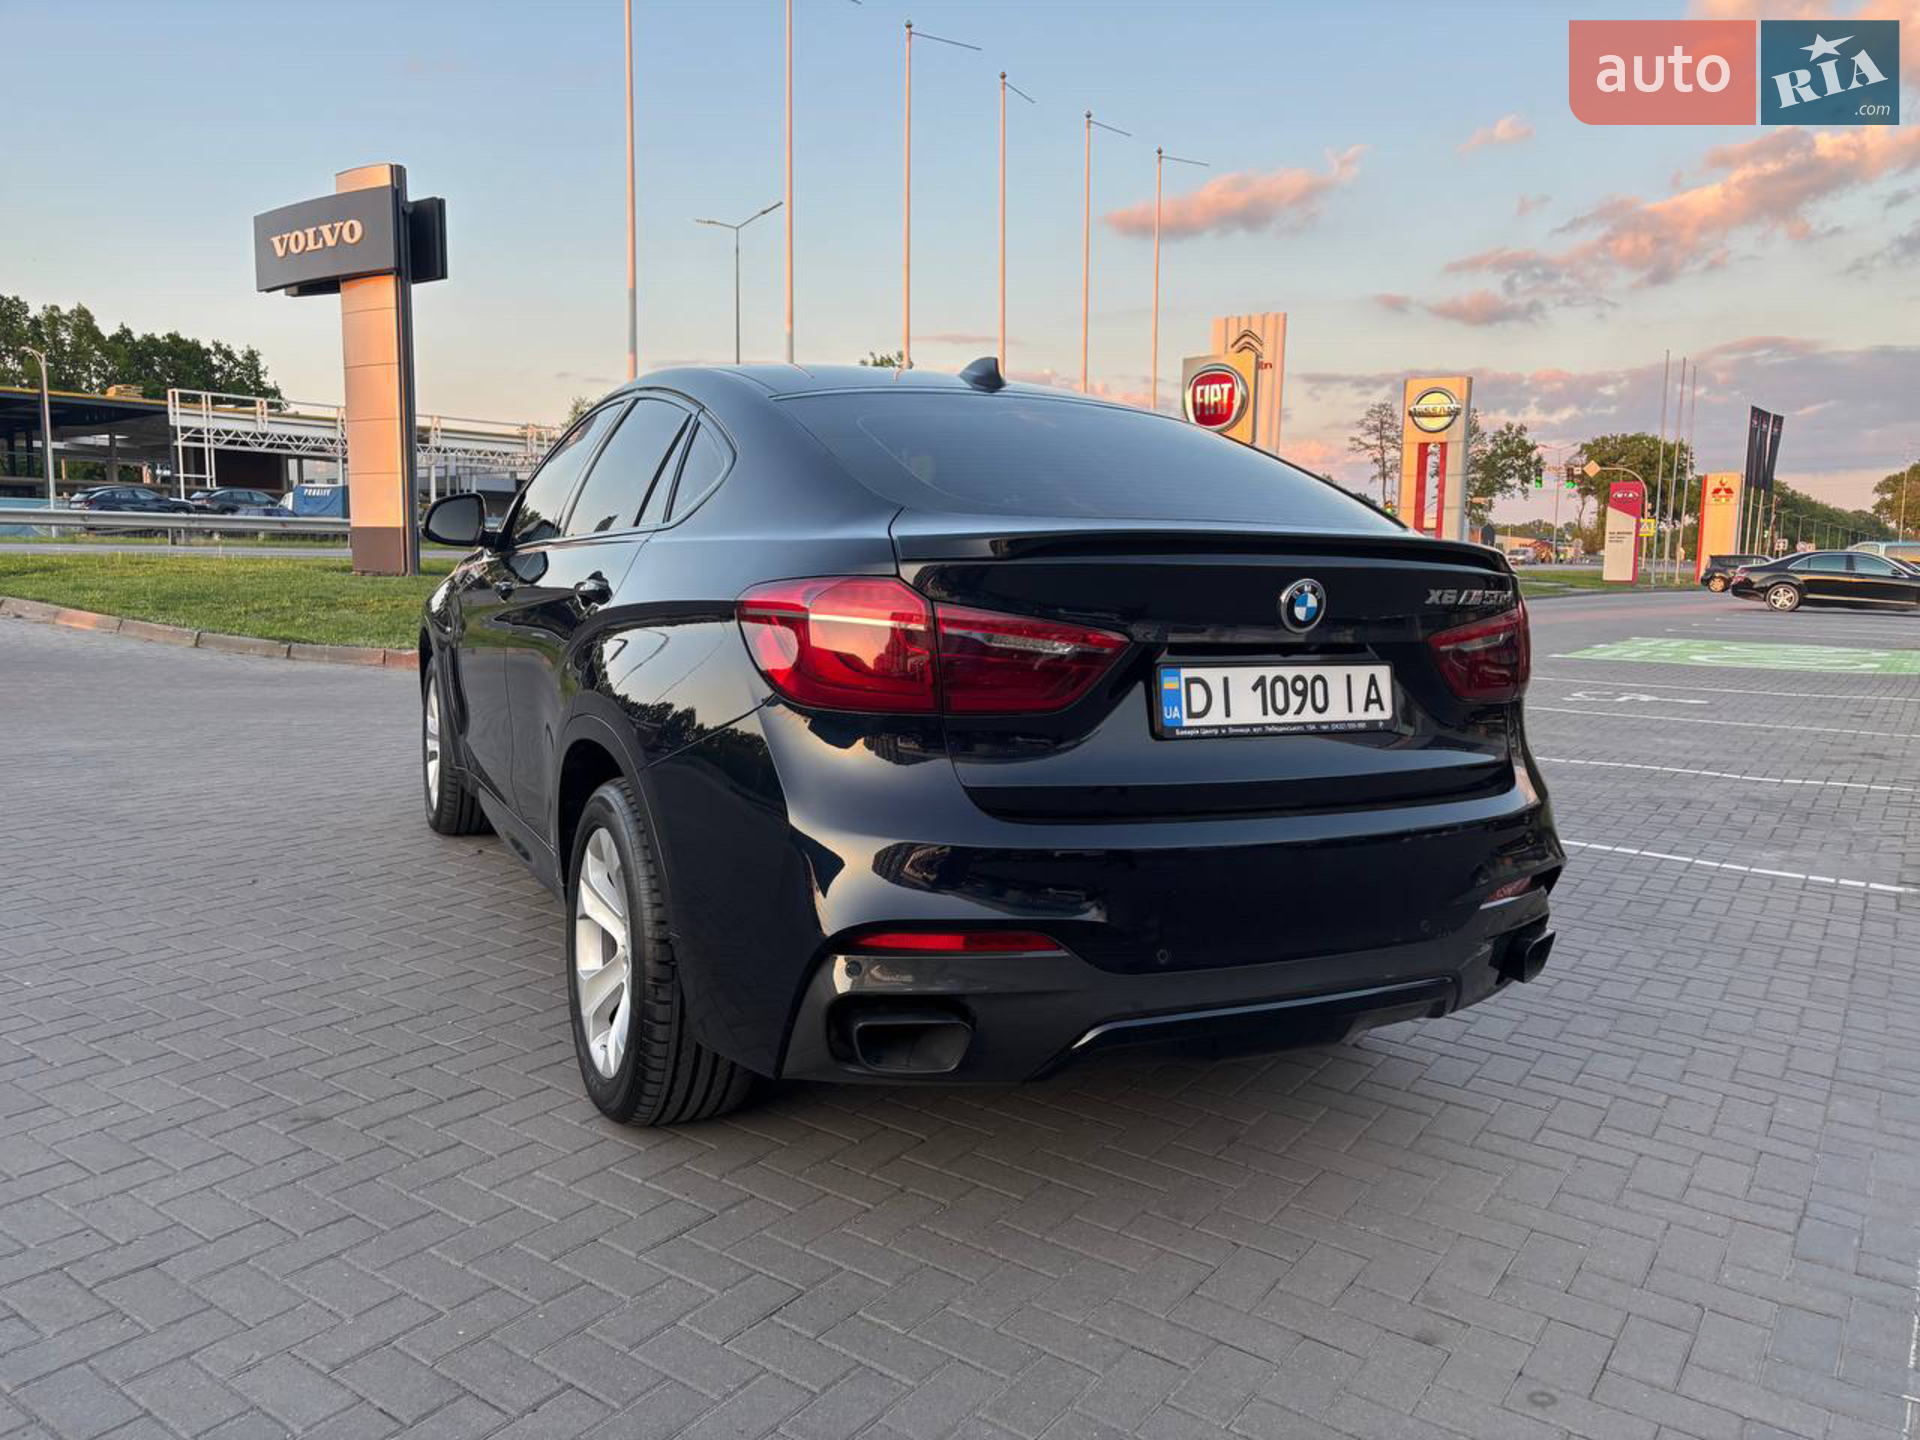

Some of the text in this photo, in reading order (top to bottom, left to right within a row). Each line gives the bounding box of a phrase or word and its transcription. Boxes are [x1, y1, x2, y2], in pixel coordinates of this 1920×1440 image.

[270, 219, 363, 258] VOLVO
[1195, 383, 1233, 417] FIAT
[1164, 706, 1181, 719] UA
[1184, 673, 1385, 719] DI 1090 IA
